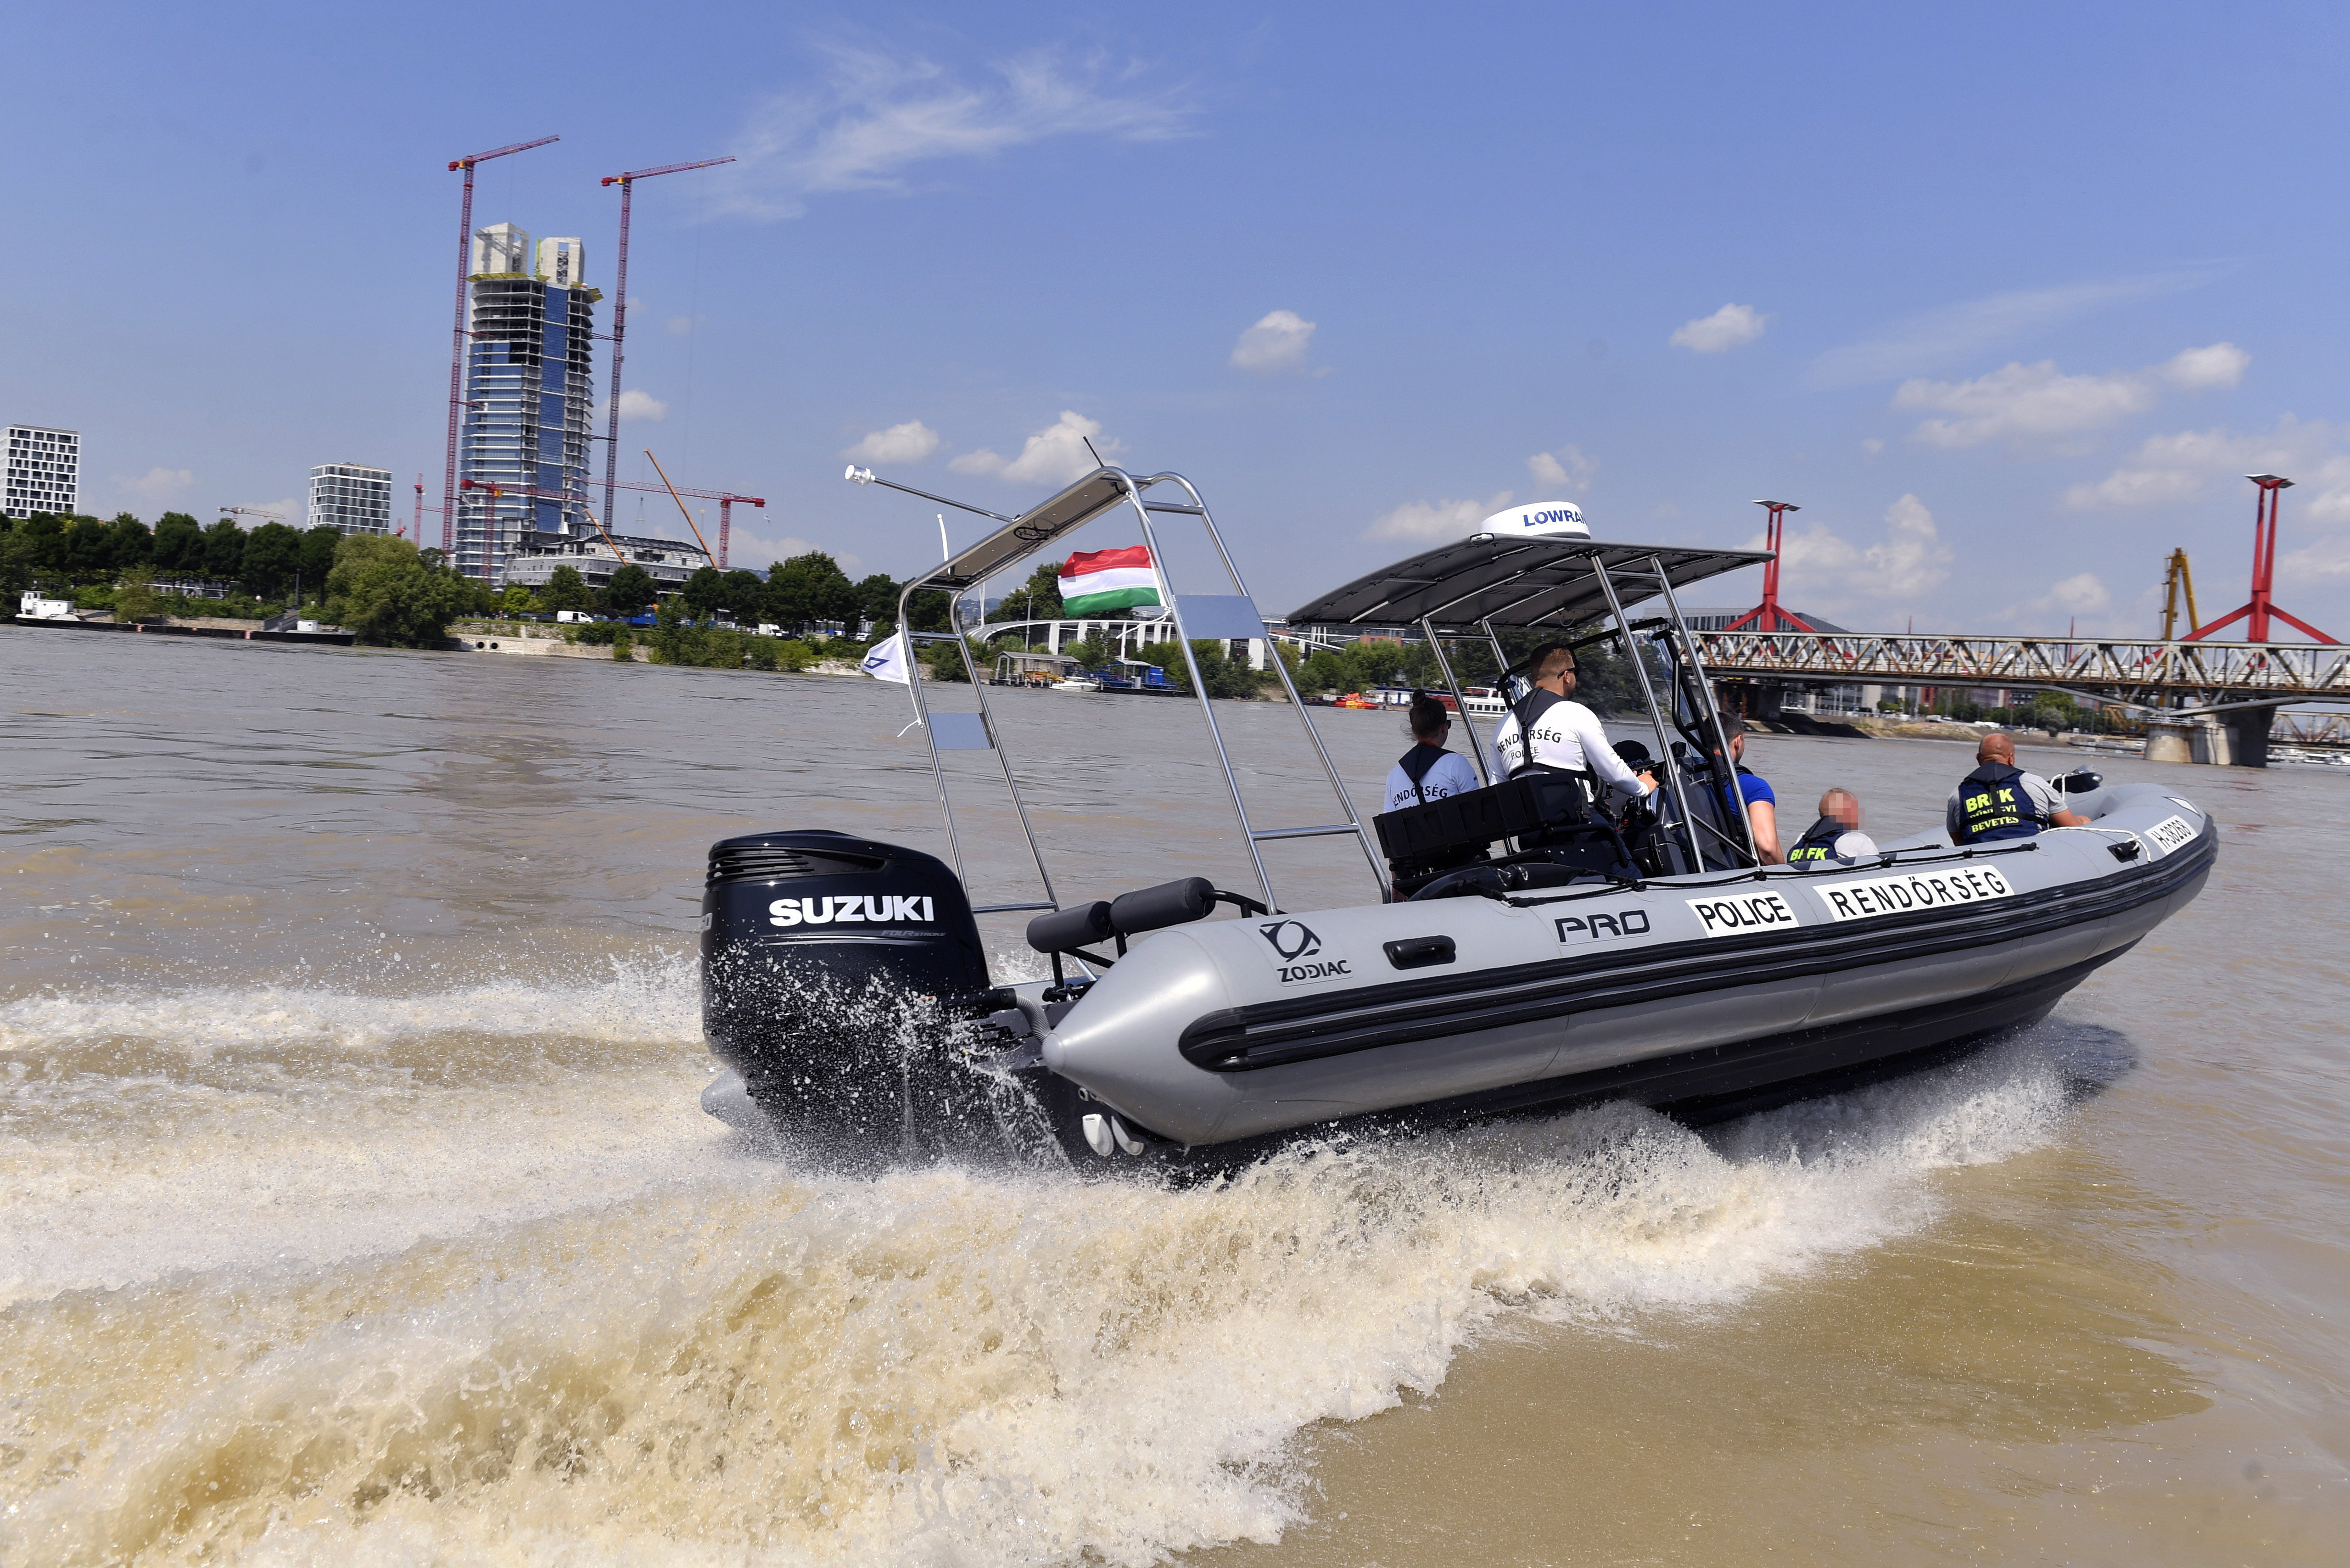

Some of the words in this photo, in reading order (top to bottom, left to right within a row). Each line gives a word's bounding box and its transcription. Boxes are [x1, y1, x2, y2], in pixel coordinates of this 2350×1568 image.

[1497, 727, 1561, 756] RENDRSÉG
[1511, 746, 1539, 760] POLCE
[1966, 788, 2015, 812] BRK
[2151, 820, 2192, 849] H-38268
[1828, 870, 2006, 917] RENDŐRSÉG
[769, 896, 934, 926] SUZUKI
[1695, 896, 1792, 930] POLICE
[1554, 910, 1650, 943] PRO
[1276, 960, 1352, 983] ZODIAC
